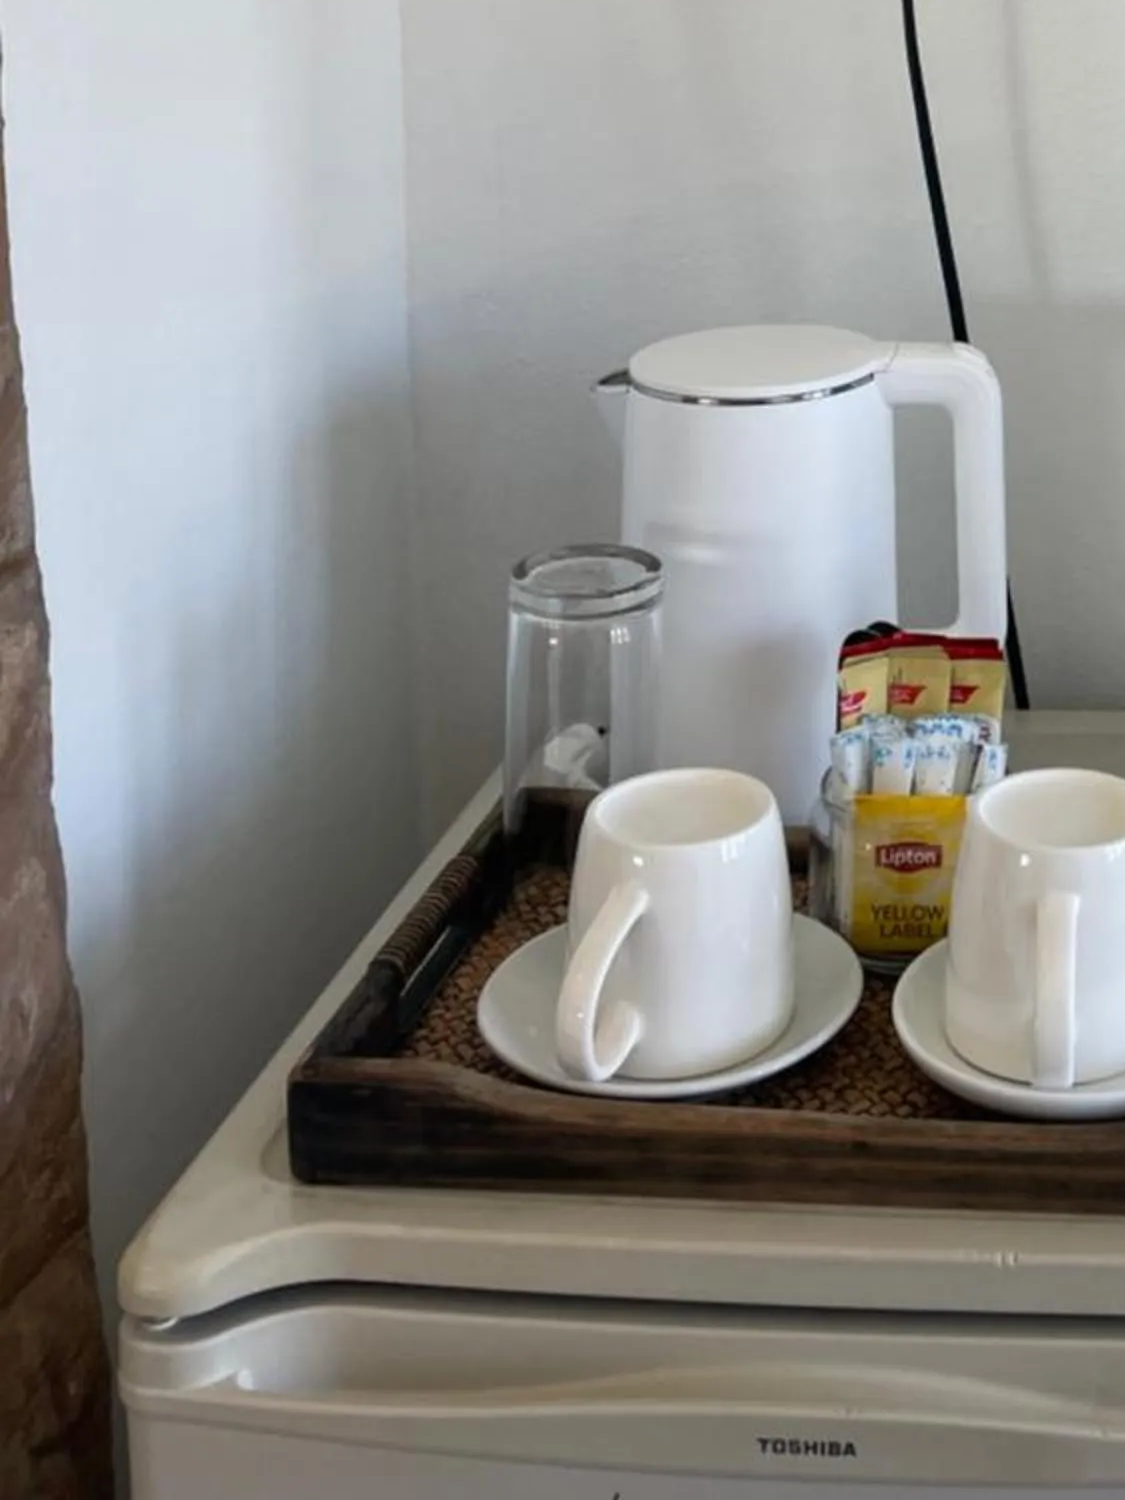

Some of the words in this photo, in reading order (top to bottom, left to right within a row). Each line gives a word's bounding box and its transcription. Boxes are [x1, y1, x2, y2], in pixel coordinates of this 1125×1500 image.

[878, 848, 938, 867] Lipton
[871, 903, 945, 922] YELLOW
[879, 922, 936, 938] LABEL
[757, 1437, 857, 1457] TOSHIBA
